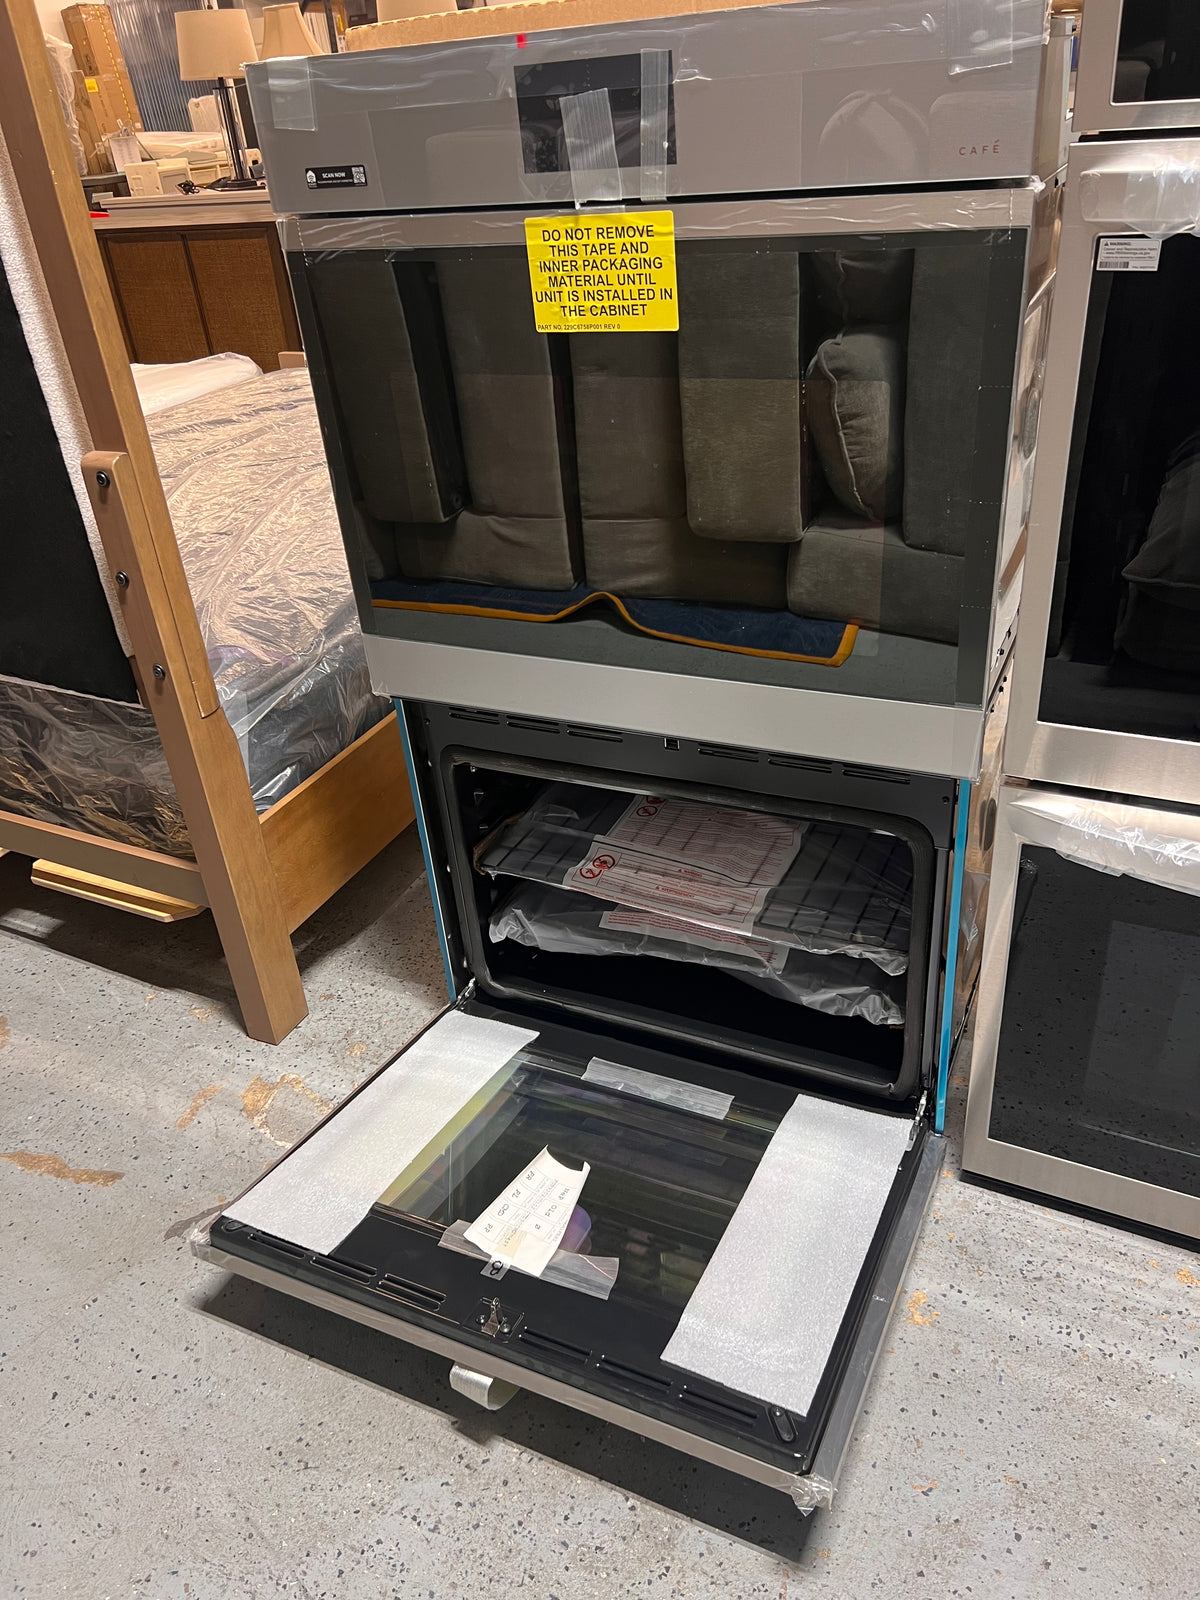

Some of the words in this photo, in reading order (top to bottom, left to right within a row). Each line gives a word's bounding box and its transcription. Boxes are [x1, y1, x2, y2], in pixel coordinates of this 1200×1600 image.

[958, 138, 1000, 156] CAFÉ
[542, 229, 561, 242] DO
[565, 227, 592, 241] NOT
[596, 225, 655, 240] REMOVE
[549, 244, 579, 257] THIS
[582, 242, 617, 256] TAPE
[620, 241, 649, 254] AND
[539, 260, 579, 273] INNER
[582, 256, 663, 272] PACKAGING
[548, 274, 614, 288] MATERIAL
[617, 273, 657, 286] UNTIL
[535, 290, 563, 303] UNIT
[567, 290, 580, 302] IS
[583, 288, 656, 302] INSTALLED
[660, 287, 673, 300] IN
[560, 305, 586, 317] THE
[589, 303, 648, 317] CABINET
